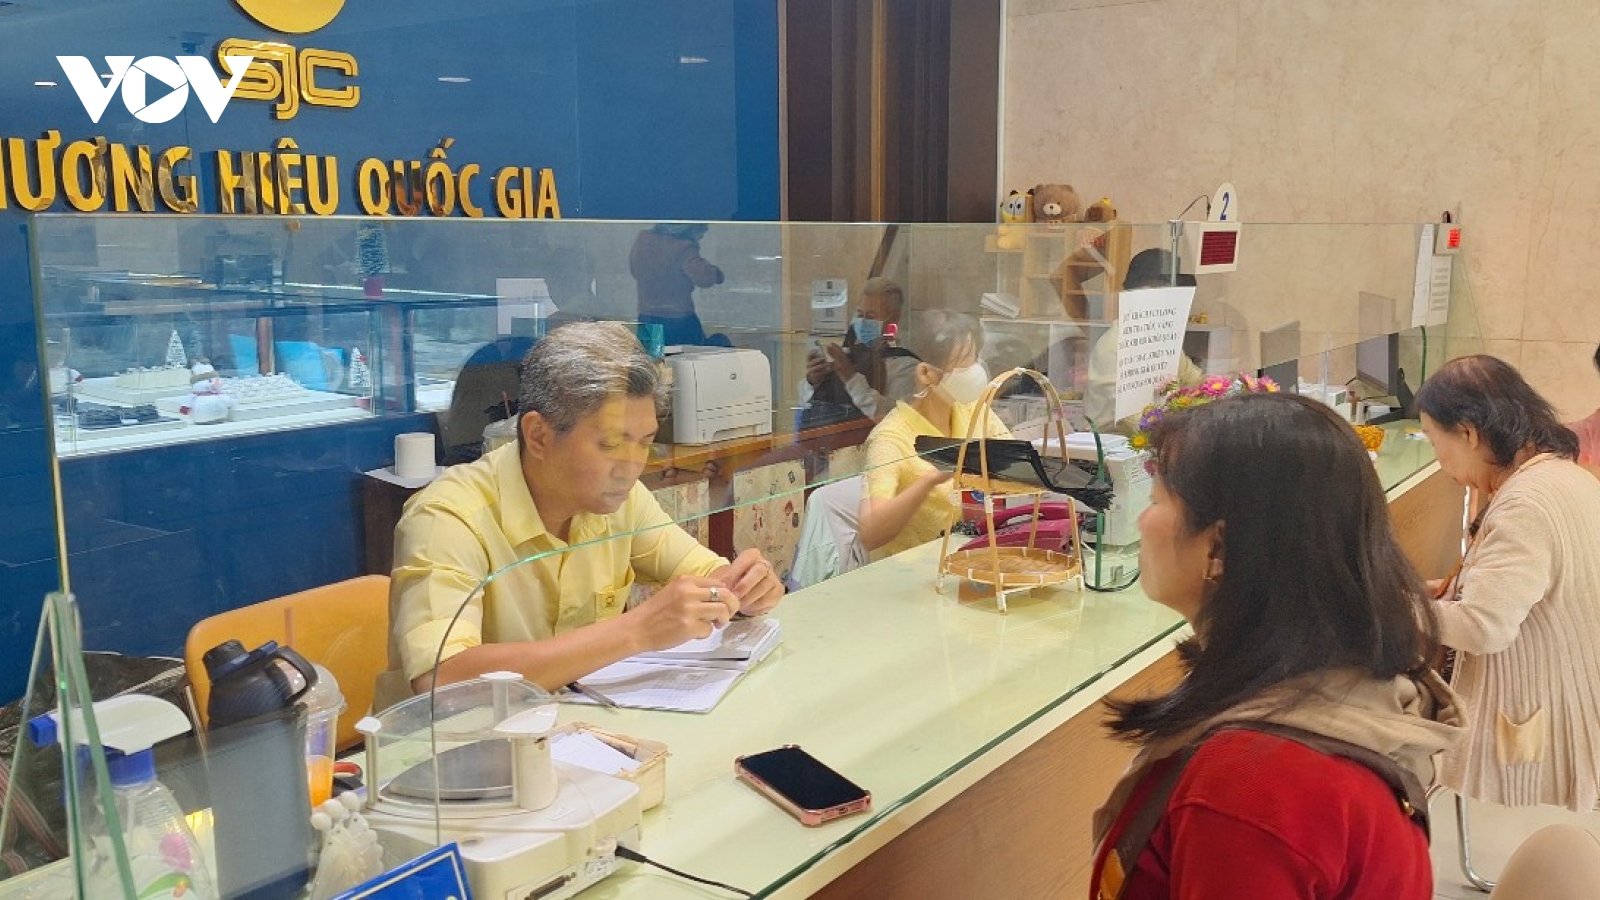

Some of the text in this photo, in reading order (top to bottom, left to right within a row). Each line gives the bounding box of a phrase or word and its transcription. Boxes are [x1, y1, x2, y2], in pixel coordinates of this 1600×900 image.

[216, 38, 360, 120] SJC
[0, 130, 198, 213] ƯƠNG
[359, 138, 483, 218] QUỐC
[497, 166, 561, 219] GIA
[1220, 191, 1229, 220] 2
